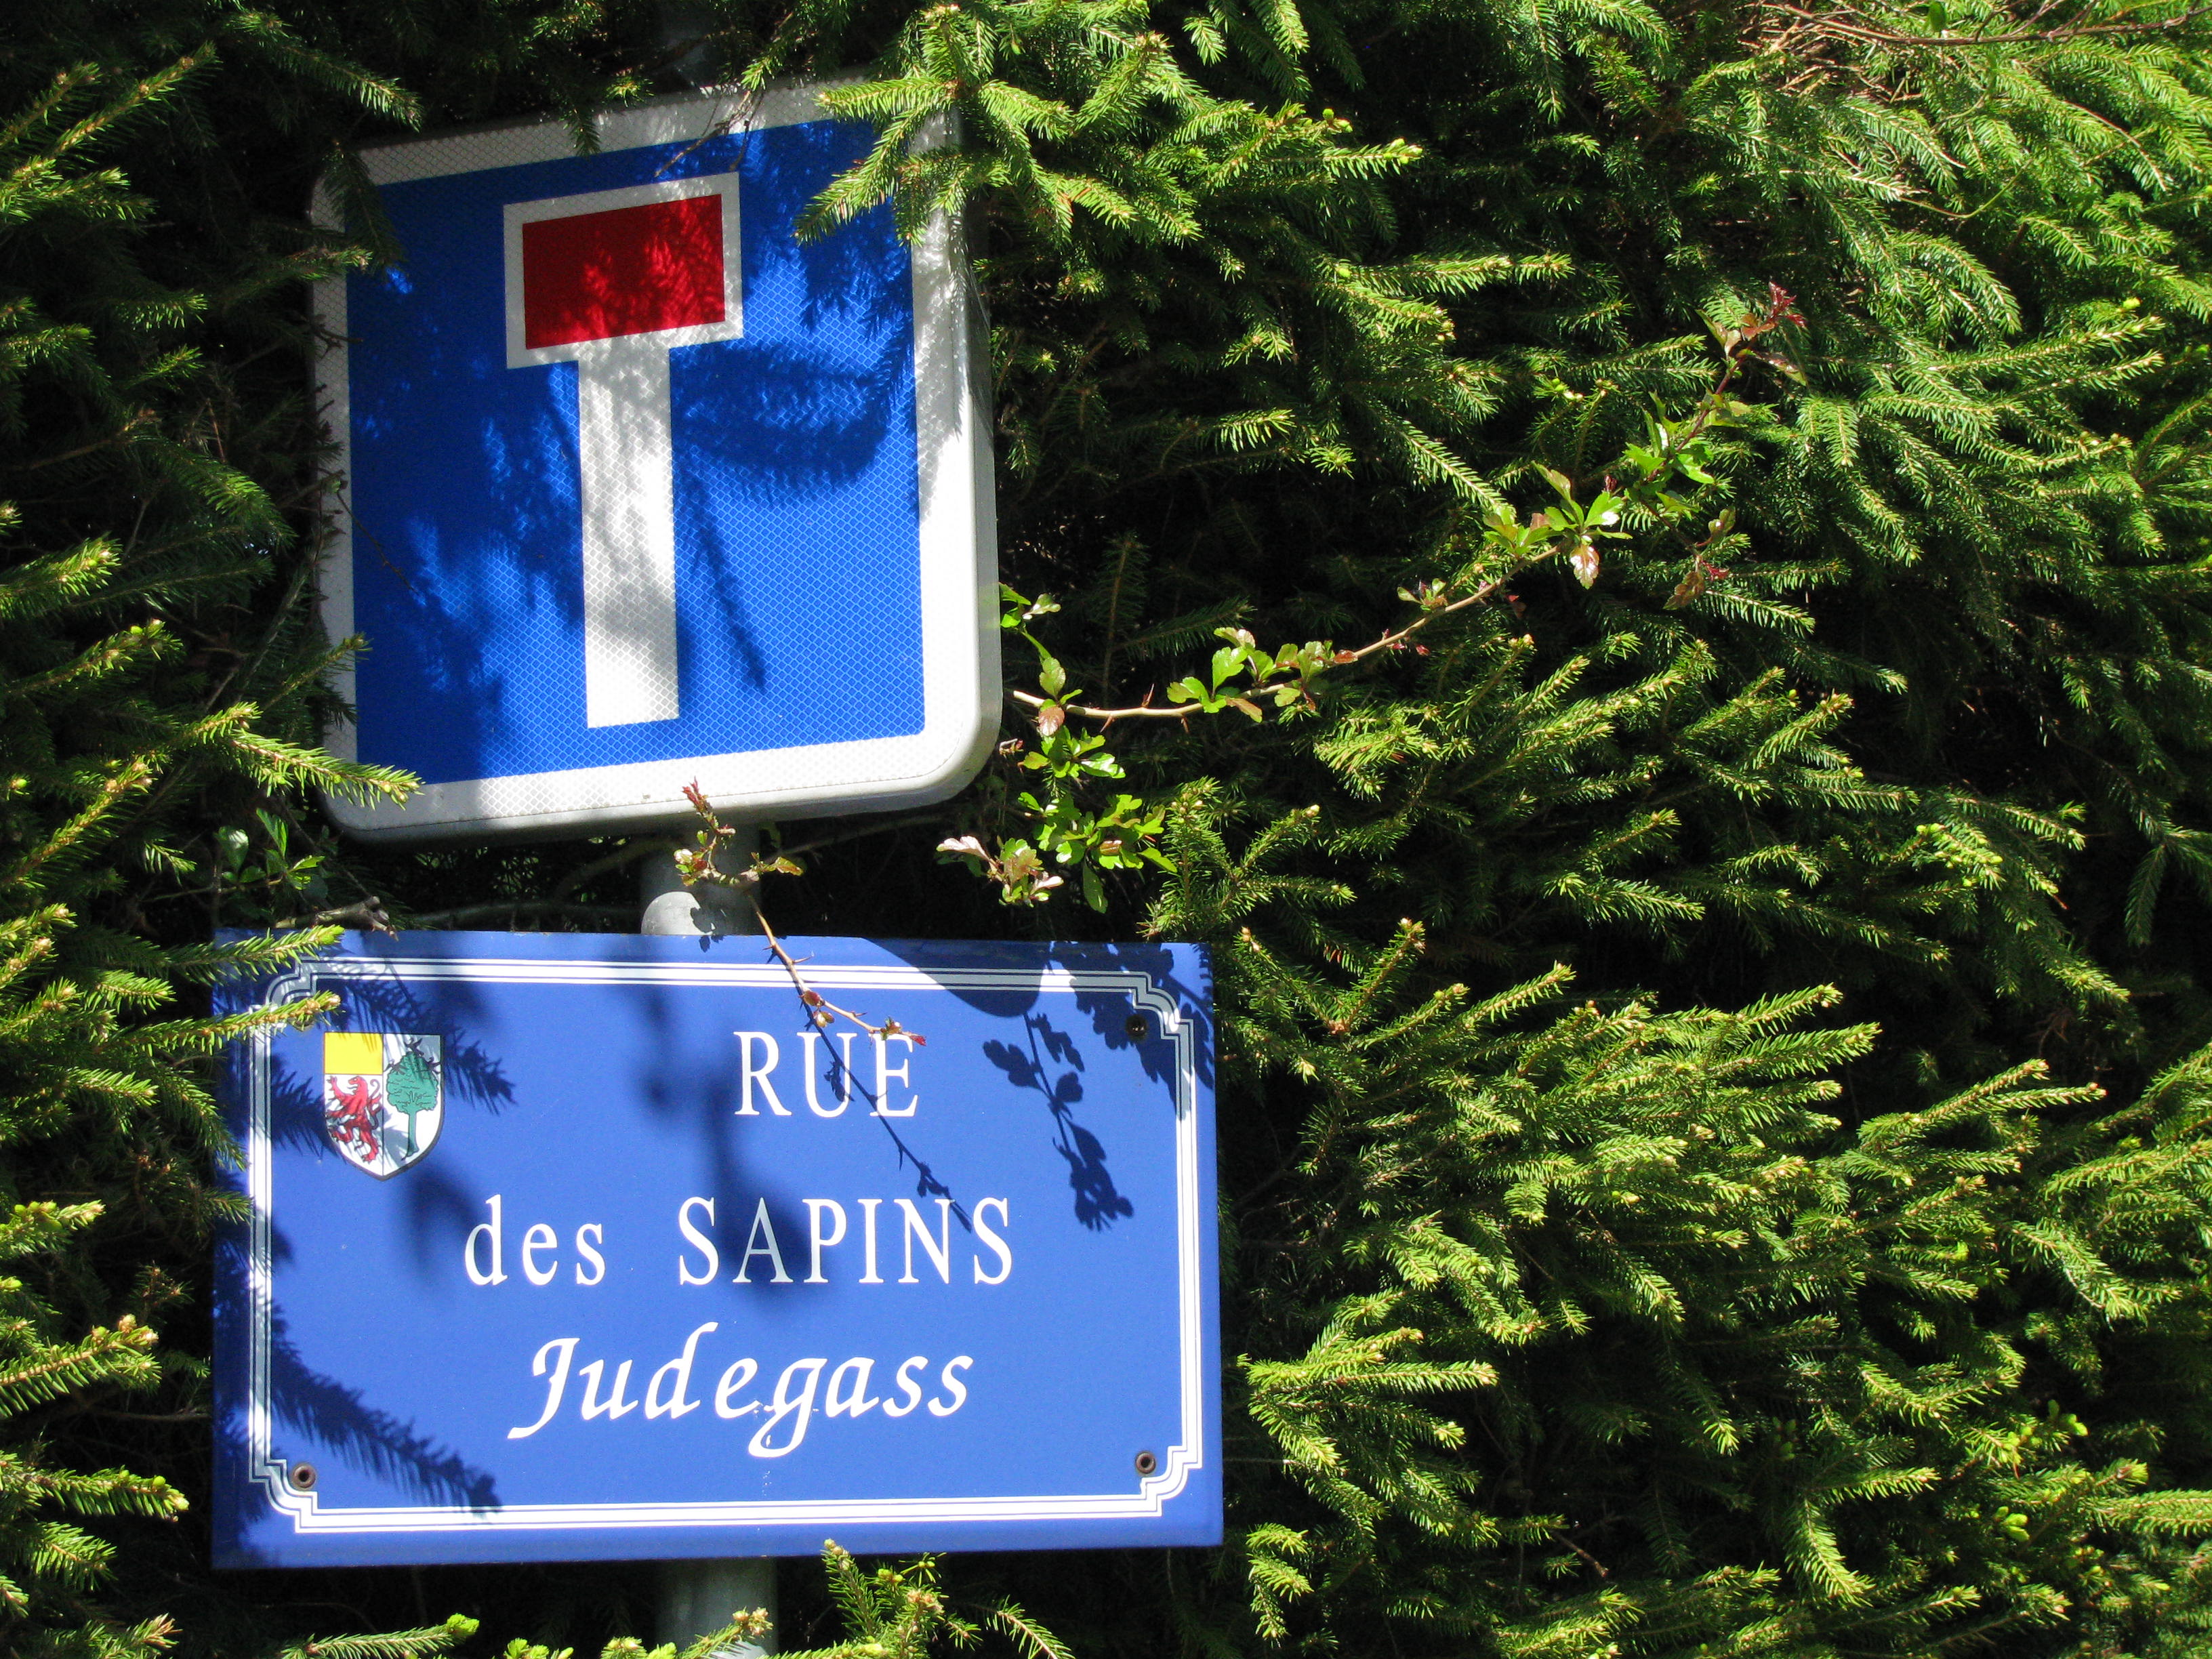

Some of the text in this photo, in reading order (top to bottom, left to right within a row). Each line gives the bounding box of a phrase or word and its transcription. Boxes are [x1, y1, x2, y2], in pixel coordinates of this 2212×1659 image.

[733, 1031, 919, 1119] RUE
[464, 1194, 1013, 1287] des SAPINS
[507, 1322, 974, 1460] Judegass
